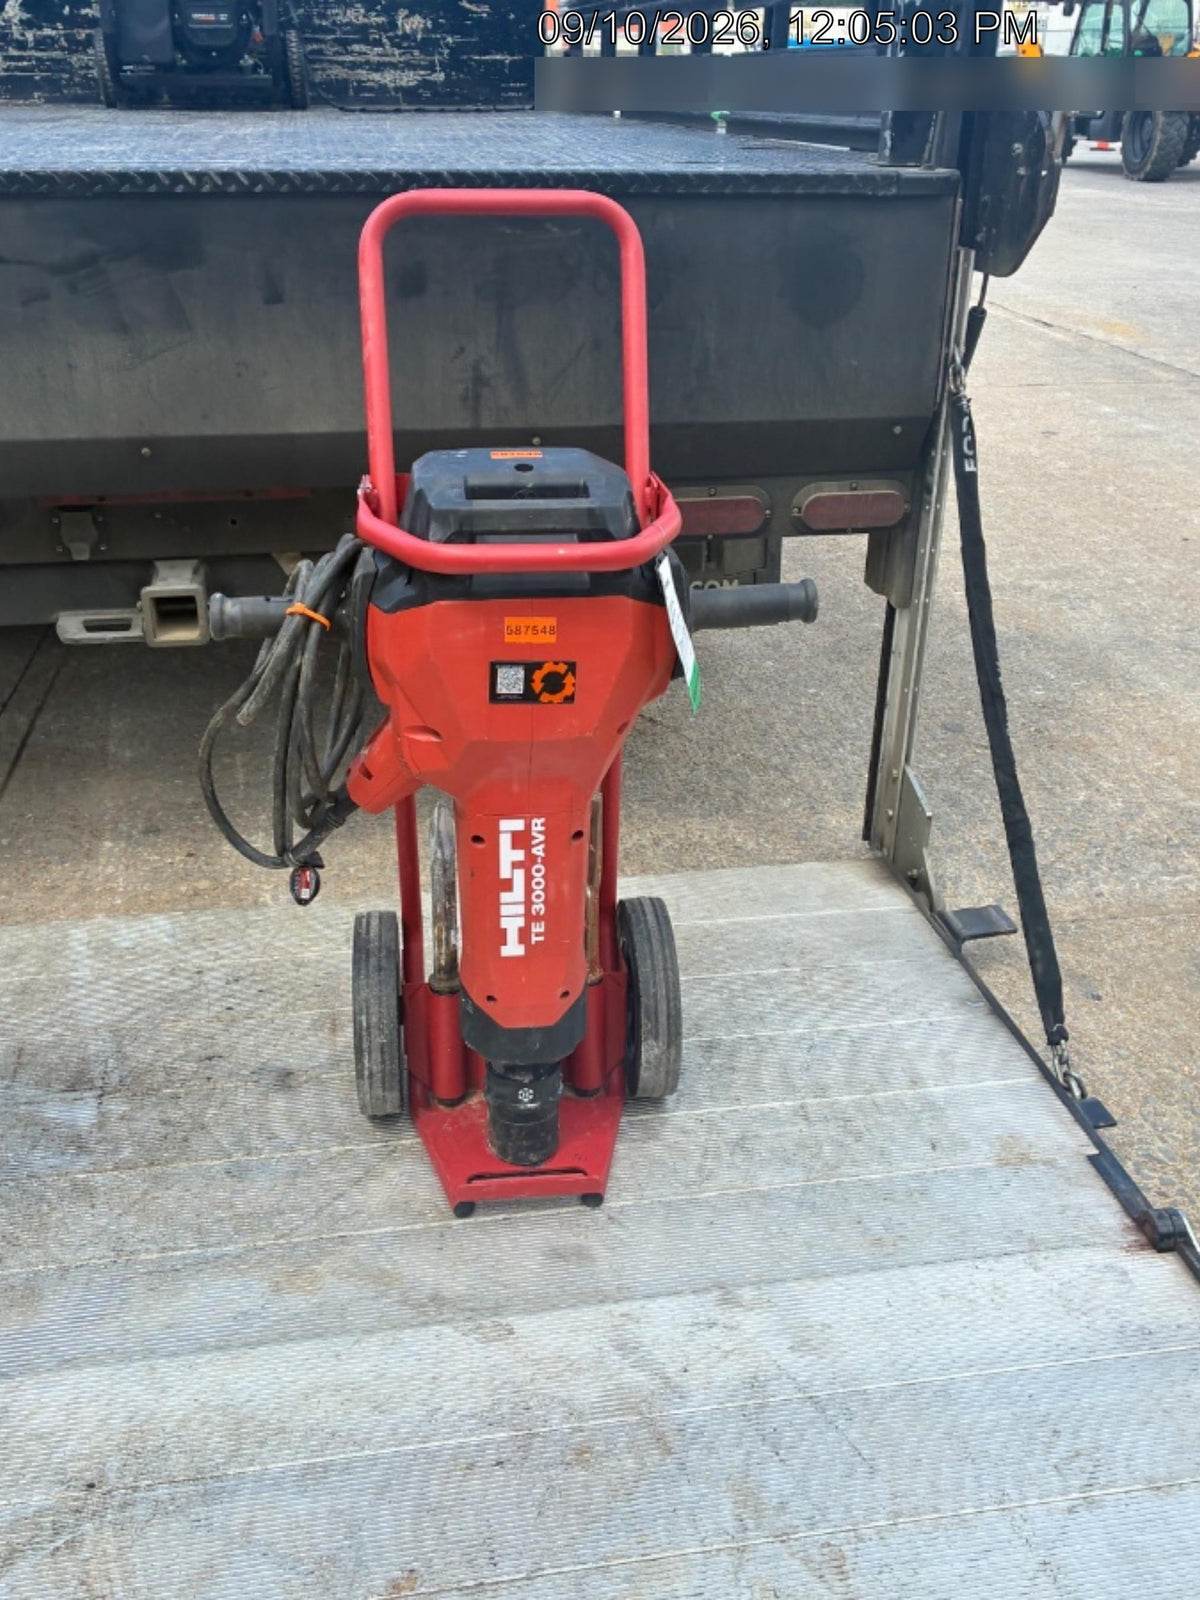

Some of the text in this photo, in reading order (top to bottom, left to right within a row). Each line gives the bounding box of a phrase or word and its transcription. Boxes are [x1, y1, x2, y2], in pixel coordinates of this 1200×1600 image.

[499, 819, 525, 957] HILTI
[531, 817, 546, 945] TE 3000-AVR
